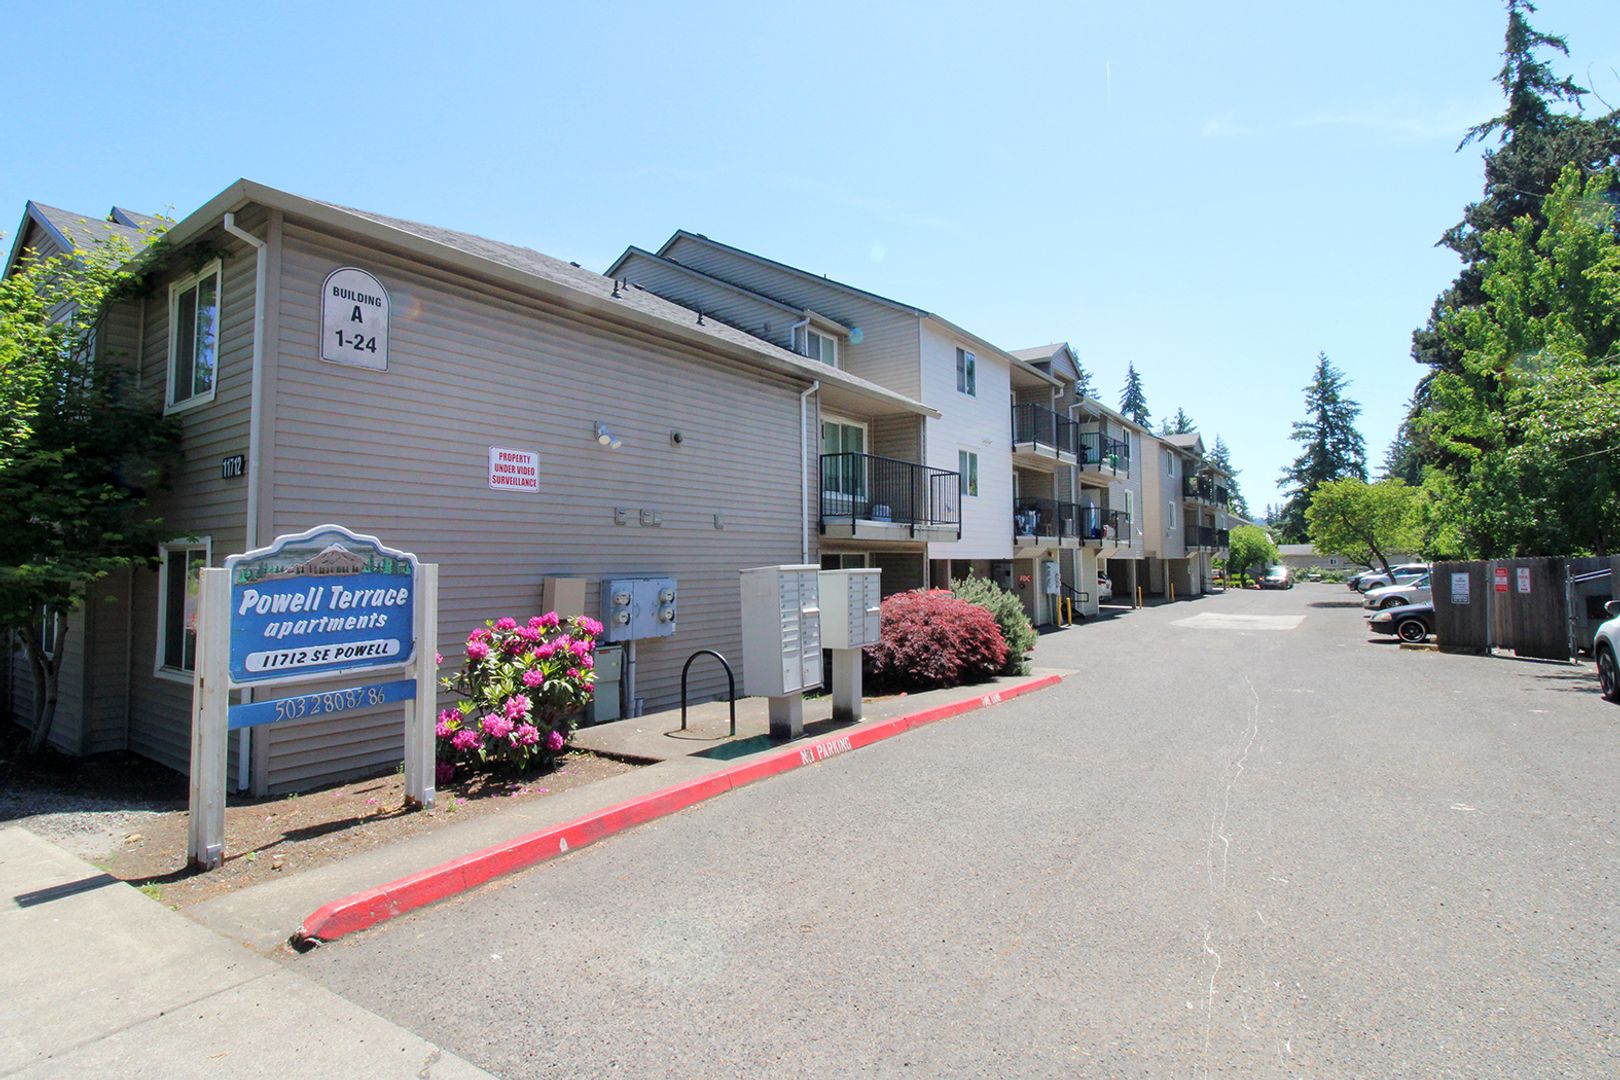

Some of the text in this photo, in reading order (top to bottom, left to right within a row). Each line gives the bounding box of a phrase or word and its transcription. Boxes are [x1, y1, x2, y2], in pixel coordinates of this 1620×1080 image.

[333, 286, 382, 307] BUILDING
[351, 305, 363, 323] A
[336, 329, 377, 353] 1-24
[223, 456, 241, 477] 11712
[499, 452, 531, 464] PROPERTY
[494, 463, 535, 476] UNDER VIDEO
[492, 475, 537, 487] SURVEILLANCE
[238, 585, 409, 616] Powell Terrace
[264, 612, 388, 640] apartments
[262, 643, 389, 668] 11712 SE POWELL
[799, 736, 852, 765] NO PARKING
